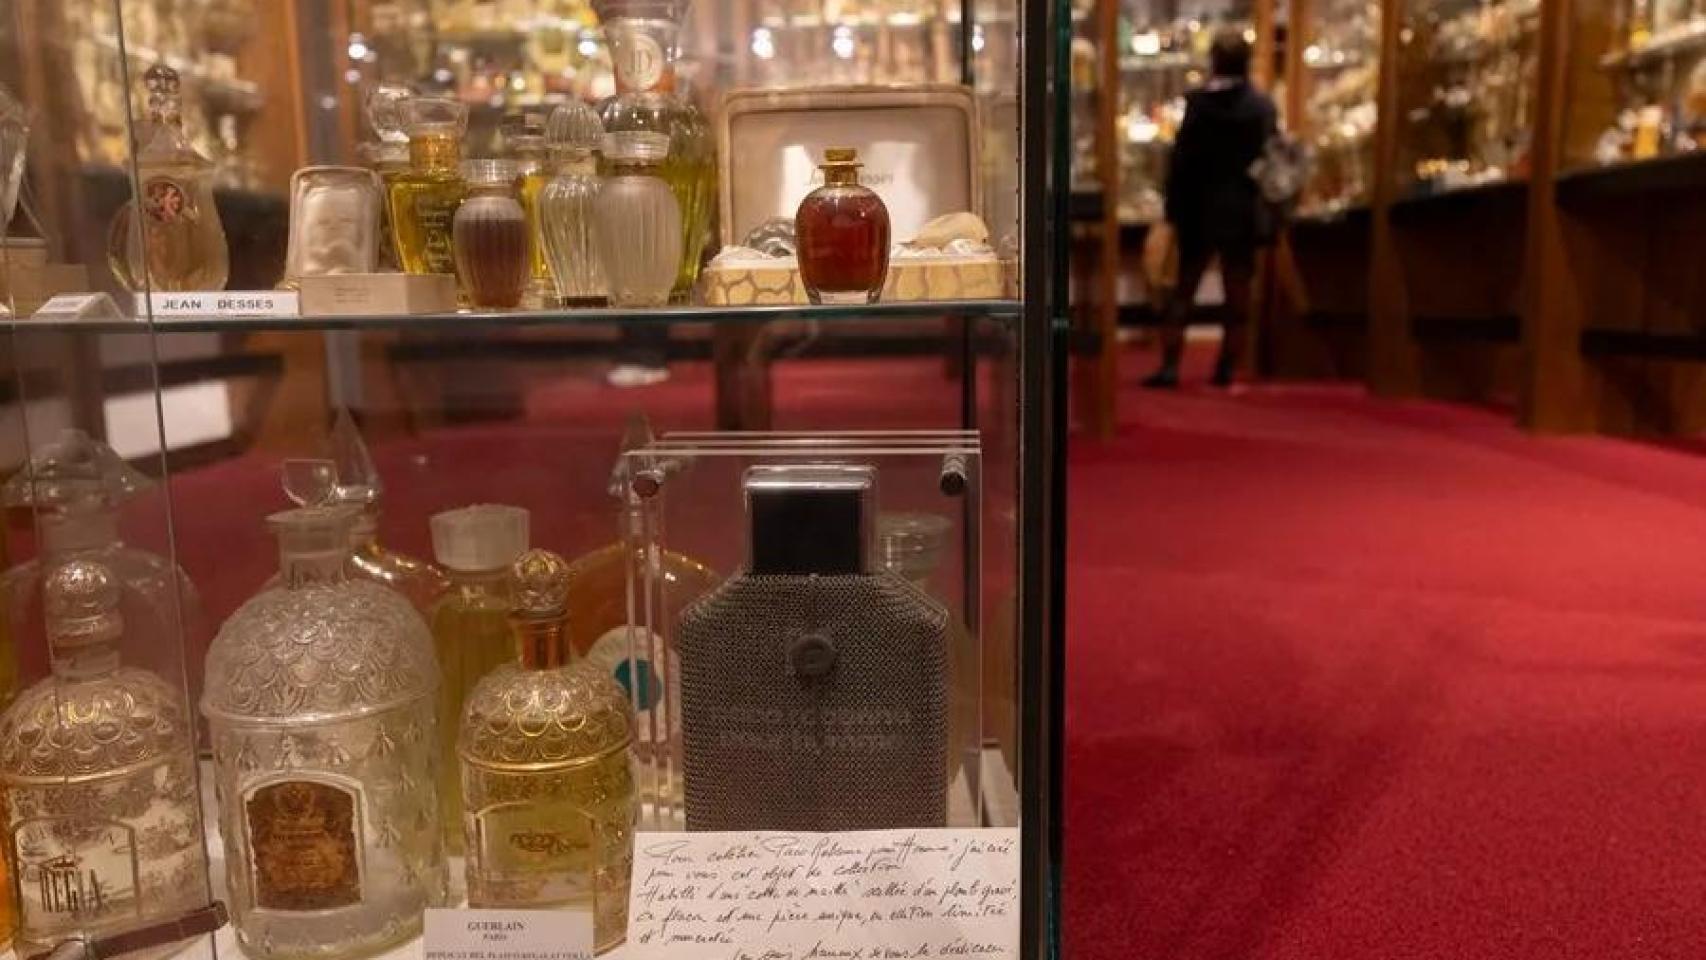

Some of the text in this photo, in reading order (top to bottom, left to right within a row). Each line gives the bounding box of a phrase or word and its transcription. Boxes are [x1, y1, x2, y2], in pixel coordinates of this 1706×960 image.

[162, 300, 274, 310] JEAN DESSES
[685, 870, 718, 880] vous
[468, 921, 525, 931] GUERLAIN
